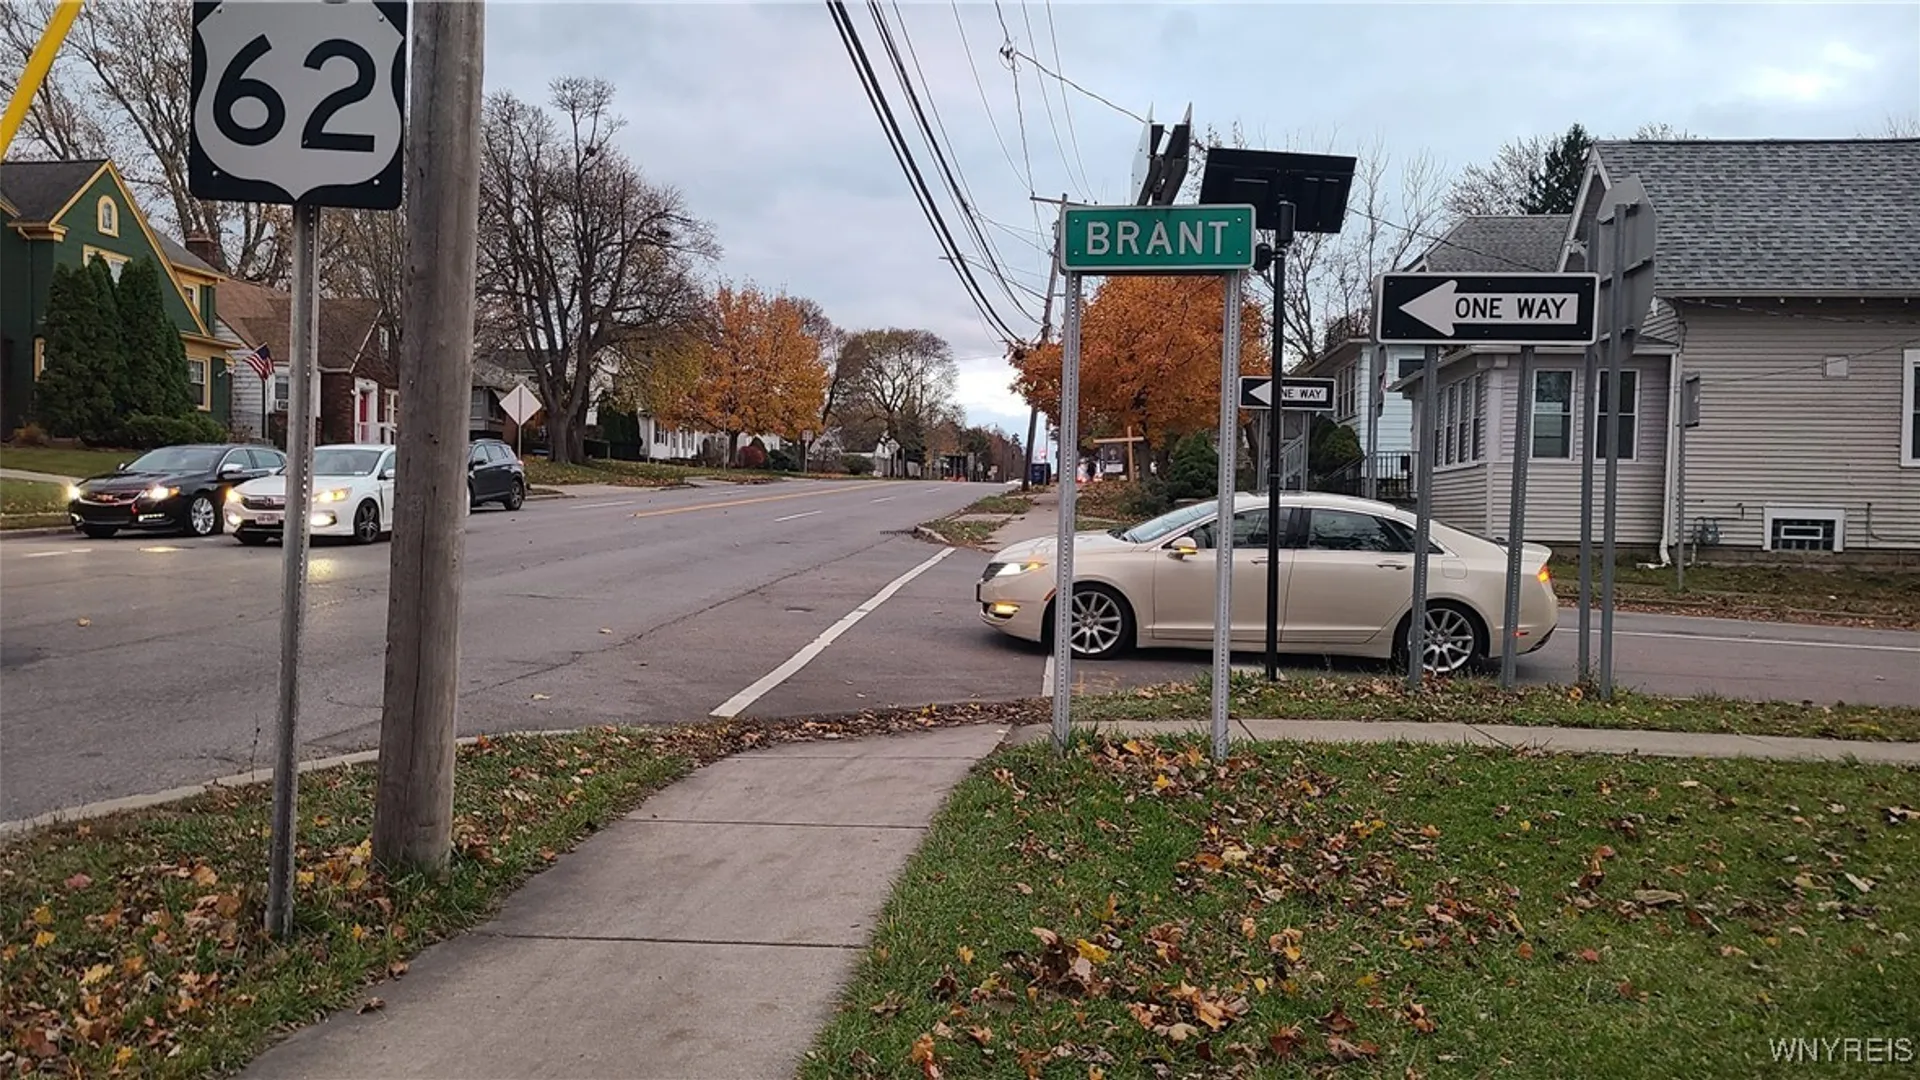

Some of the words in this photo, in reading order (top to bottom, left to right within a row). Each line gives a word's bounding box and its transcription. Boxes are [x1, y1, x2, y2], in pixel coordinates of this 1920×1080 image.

[213, 34, 376, 152] 62
[1087, 221, 1229, 255] BRANT
[1455, 297, 1503, 319] ONE
[1517, 297, 1567, 319] WAY
[1281, 388, 1295, 399] NE
[1300, 389, 1322, 399] WAY
